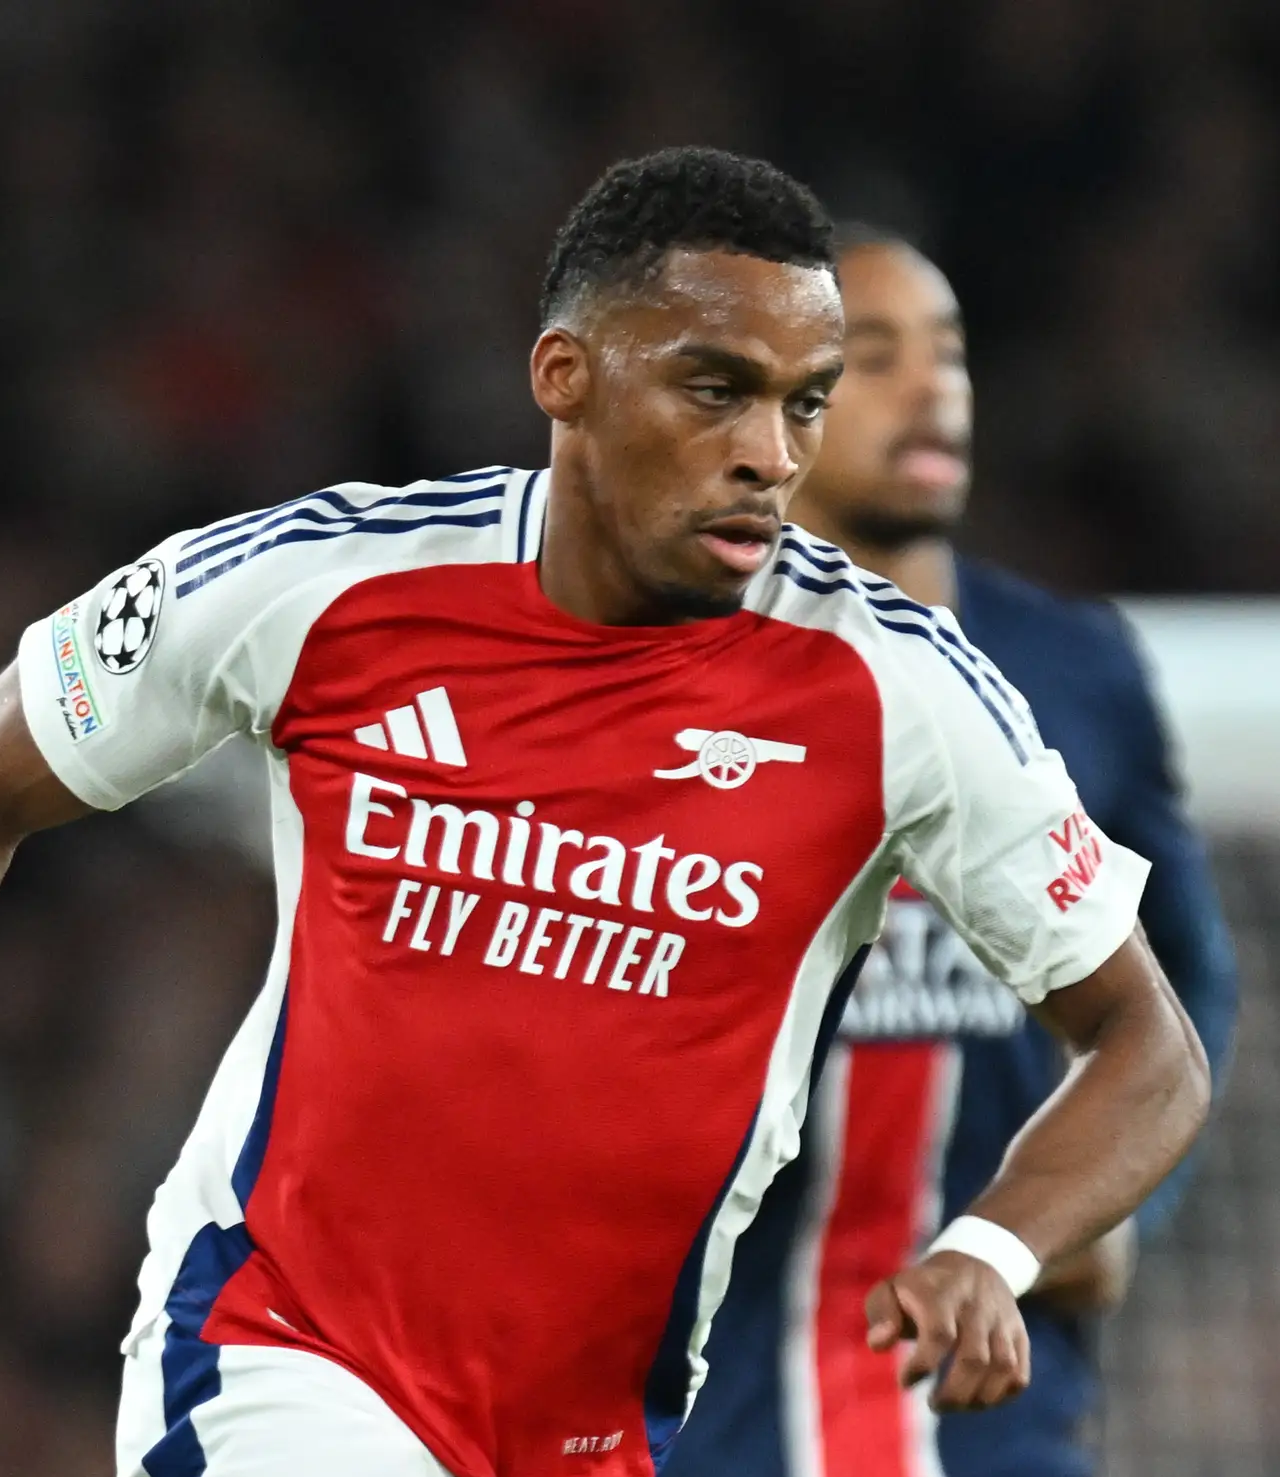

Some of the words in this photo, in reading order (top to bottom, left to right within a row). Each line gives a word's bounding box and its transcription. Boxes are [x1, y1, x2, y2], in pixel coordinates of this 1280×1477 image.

[56, 606, 97, 734] FOUNDATION
[345, 772, 764, 928] Emirates
[382, 879, 481, 957] FLY
[483, 901, 686, 998] BETTER
